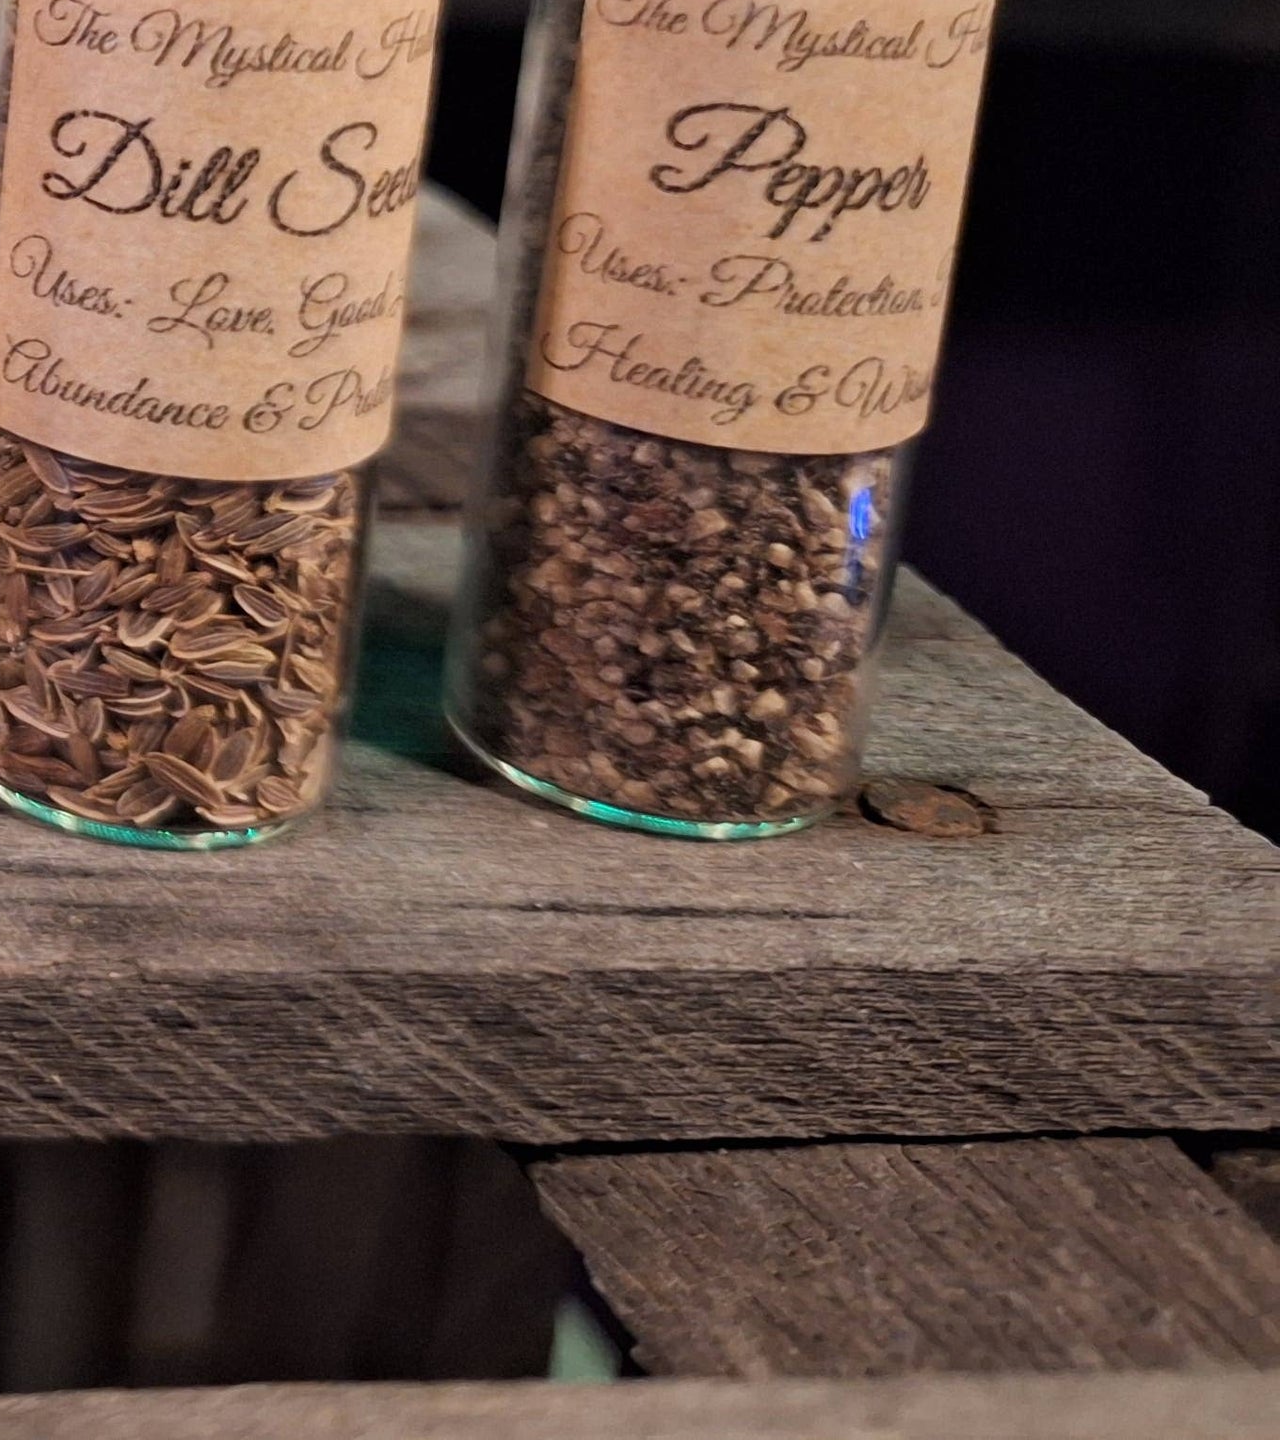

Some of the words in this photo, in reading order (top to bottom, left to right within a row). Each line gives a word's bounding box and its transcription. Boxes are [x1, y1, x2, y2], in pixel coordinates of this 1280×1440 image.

[131, 9, 350, 88] Mystical
[42, 109, 261, 225] Dill
[649, 102, 932, 242] Pepper
[10, 234, 133, 319] Uses:
[287, 271, 395, 358] Good
[557, 212, 688, 297] Uses:
[2, 335, 229, 430] Abundance
[243, 382, 295, 433] &
[543, 322, 761, 426] Healing
[774, 365, 832, 416] &
